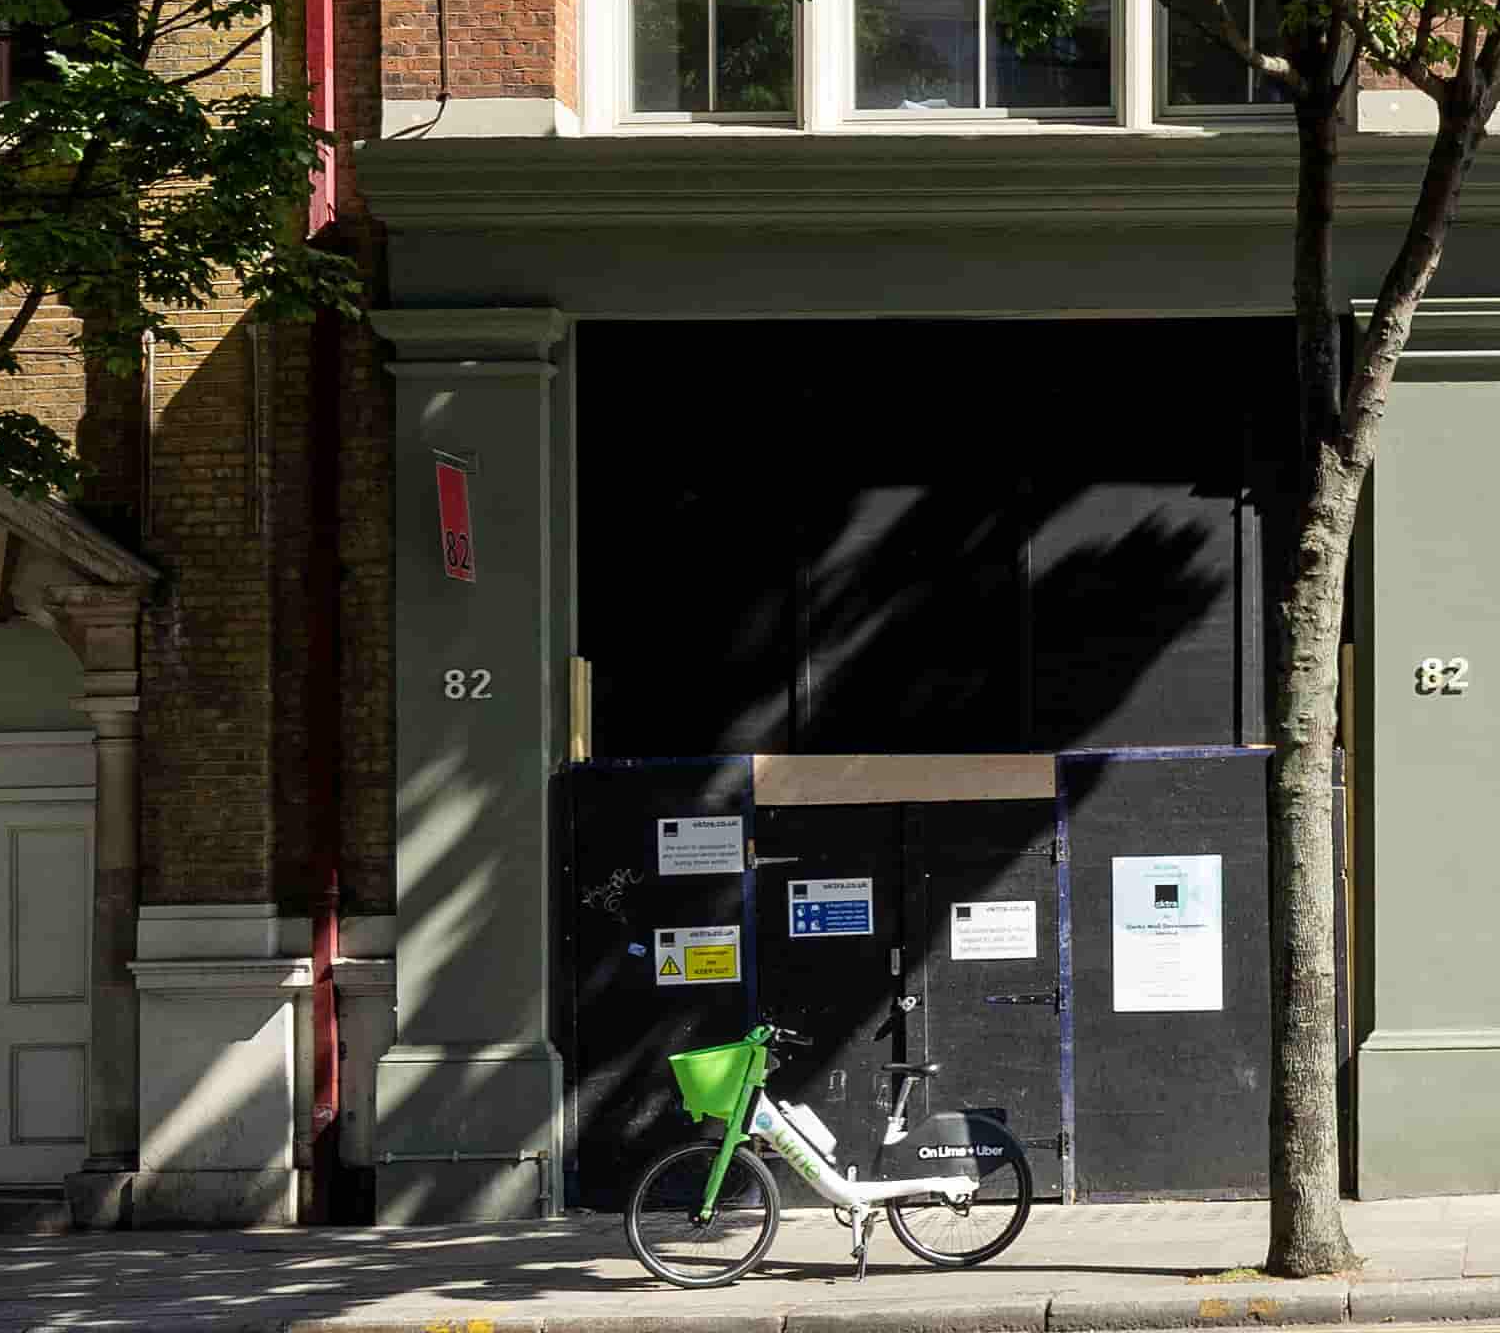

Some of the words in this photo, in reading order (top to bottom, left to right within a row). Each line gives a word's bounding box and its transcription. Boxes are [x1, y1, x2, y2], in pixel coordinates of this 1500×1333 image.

[443, 669, 493, 699] 82
[1420, 656, 1469, 690] 82
[918, 1146, 938, 1159] On
[938, 1145, 967, 1158] Lime
[976, 1145, 1004, 1157] Uber
